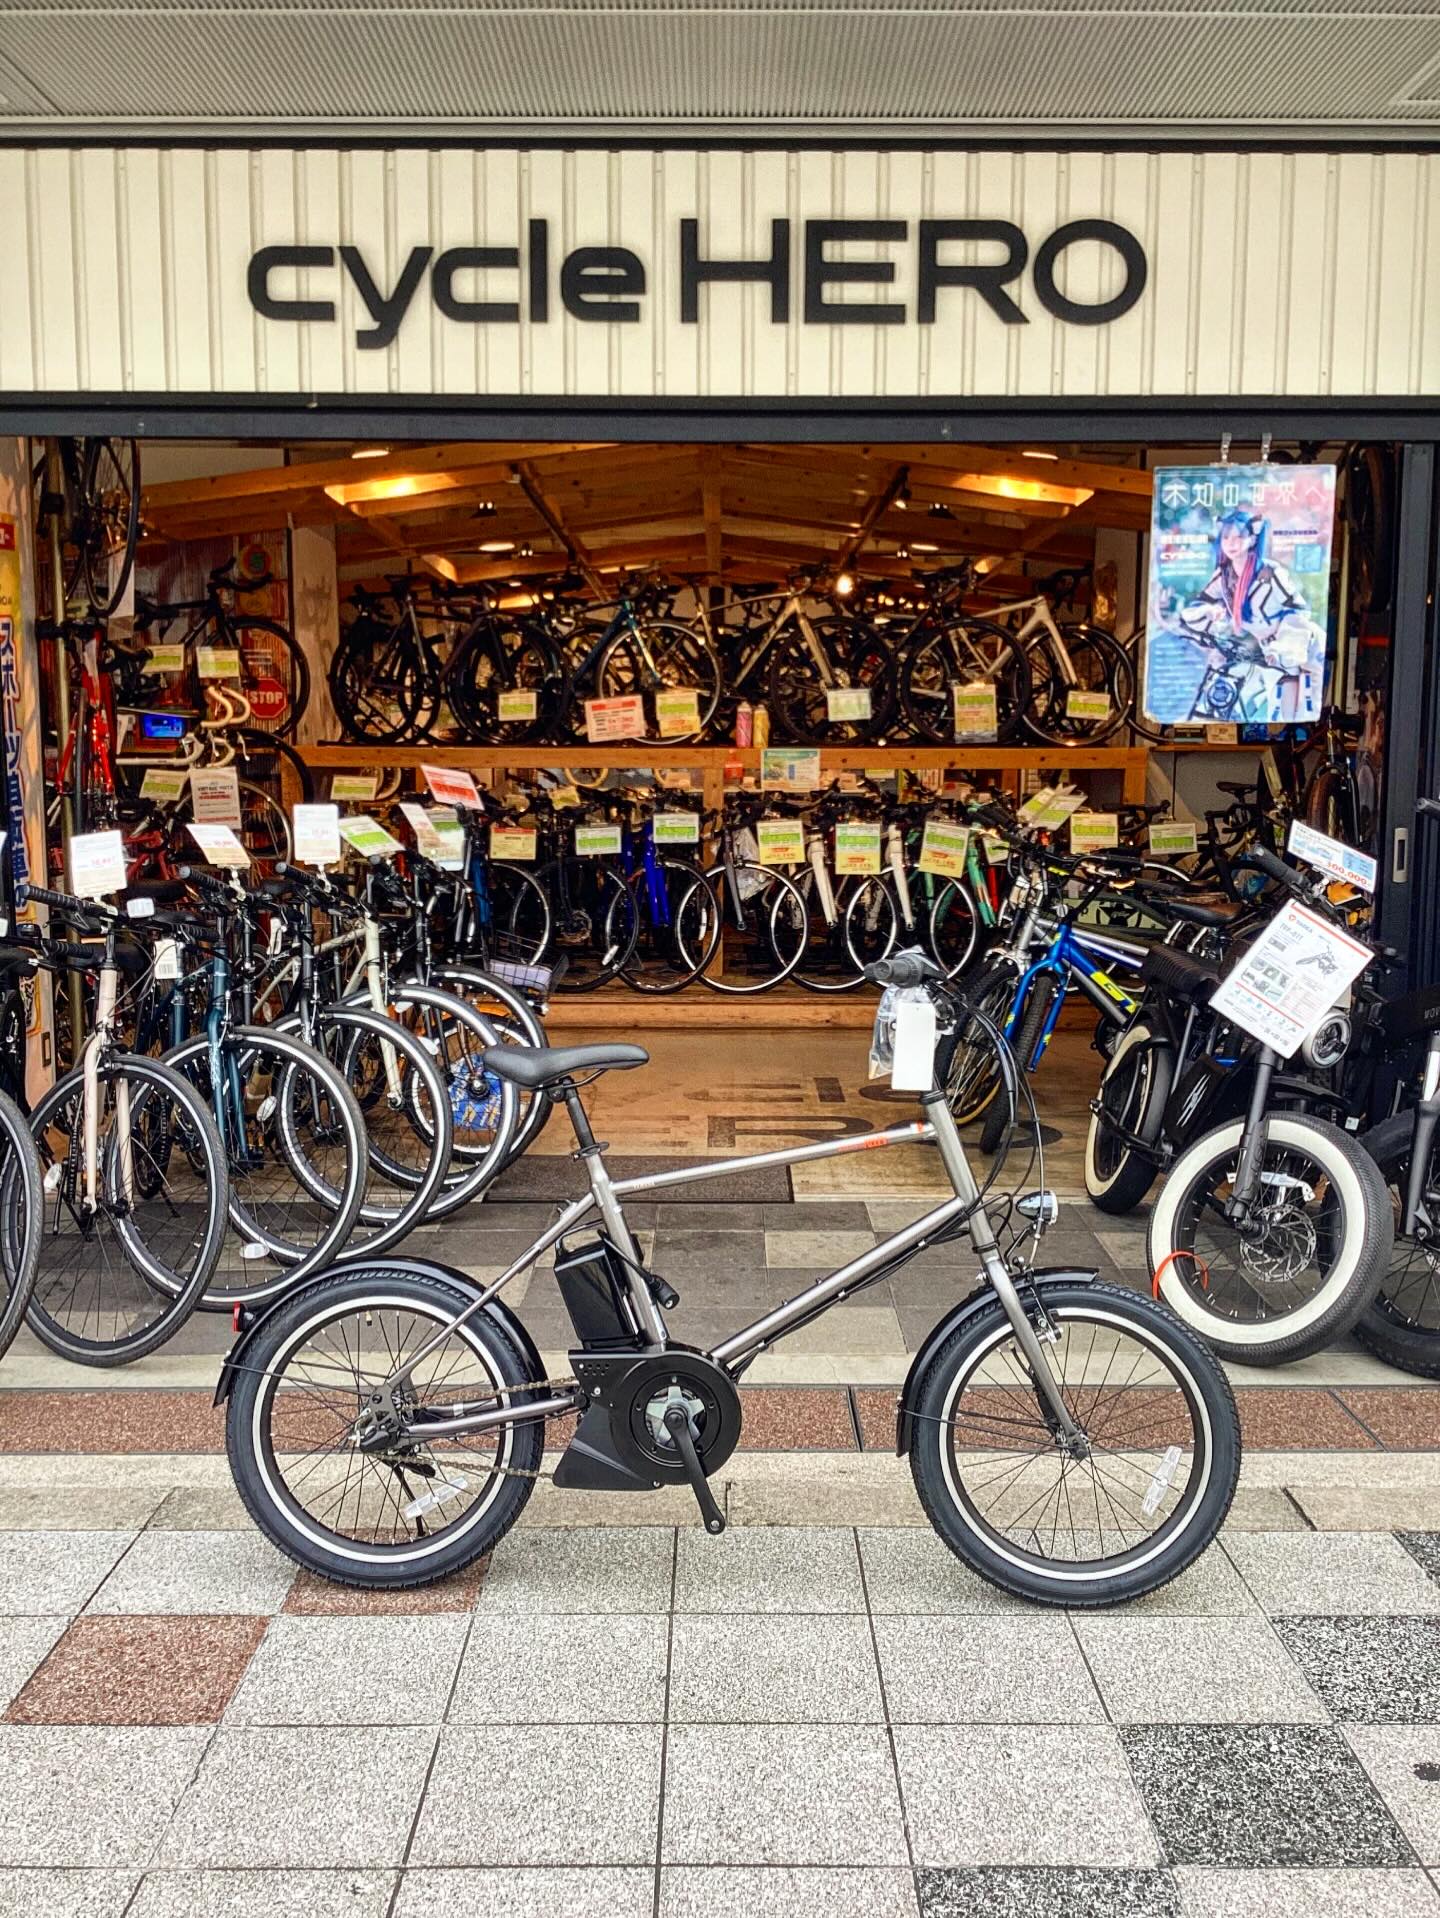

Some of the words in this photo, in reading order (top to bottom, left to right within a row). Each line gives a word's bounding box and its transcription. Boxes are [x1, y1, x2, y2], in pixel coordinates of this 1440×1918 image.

[247, 219, 646, 350] cycle
[680, 218, 1148, 326] HERO
[251, 691, 283, 704] STOP
